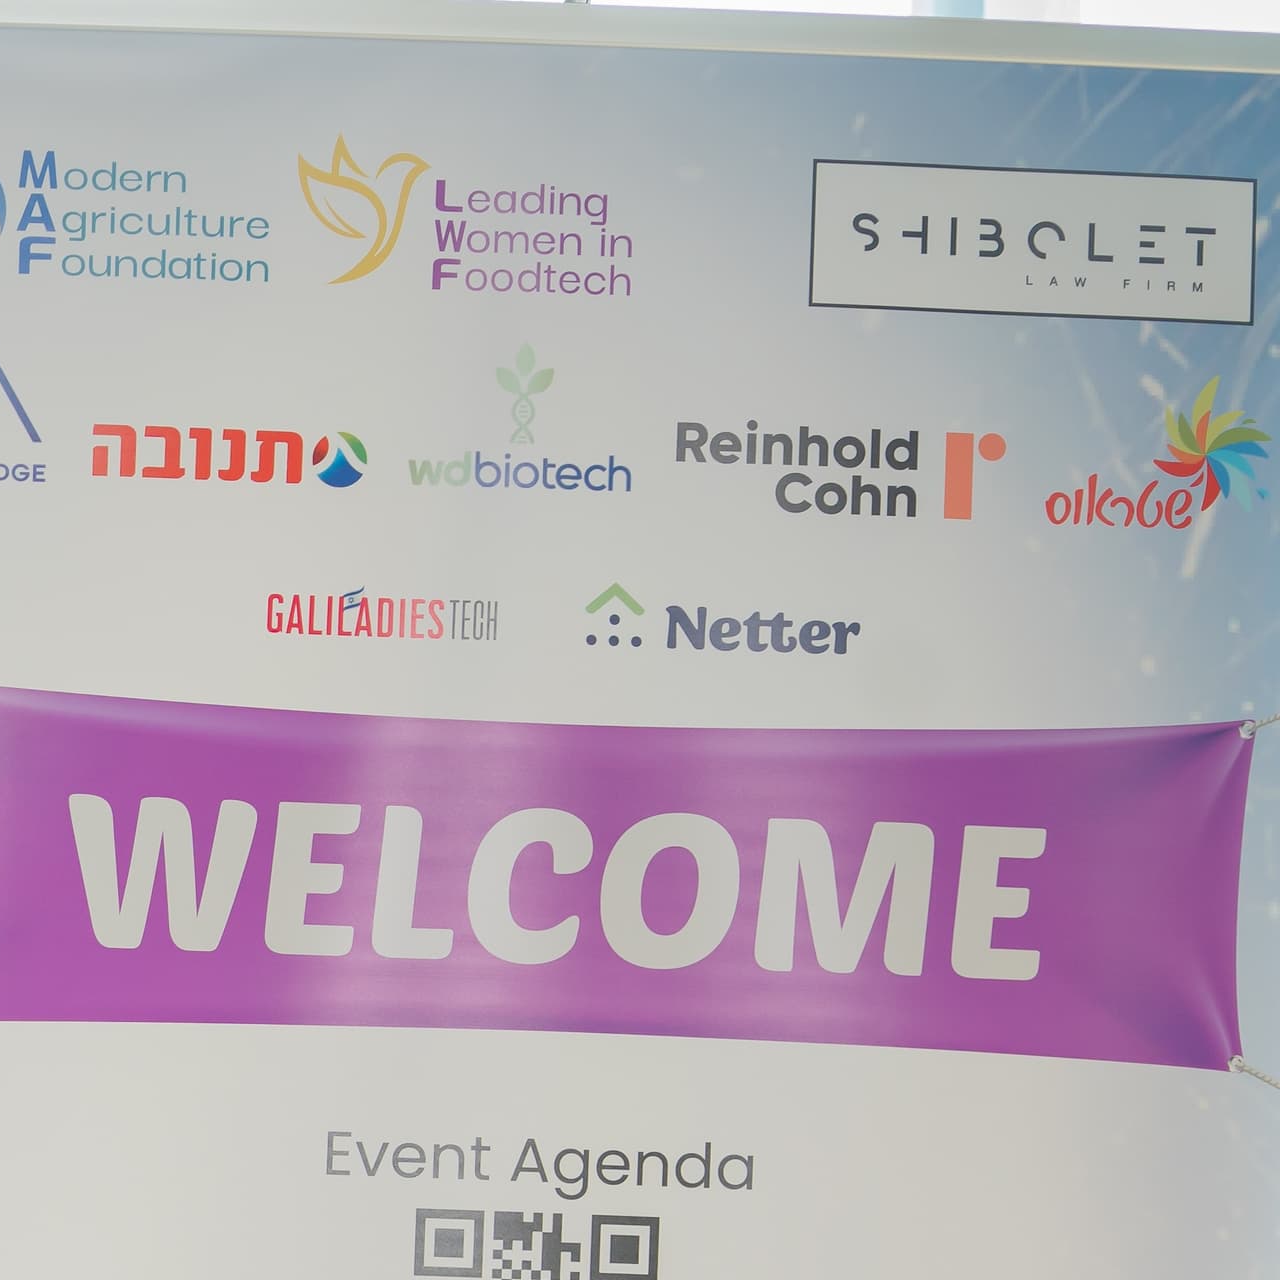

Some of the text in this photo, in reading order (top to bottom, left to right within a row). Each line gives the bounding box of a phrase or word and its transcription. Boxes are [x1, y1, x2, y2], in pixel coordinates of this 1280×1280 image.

[18, 150, 187, 193] Modern
[17, 192, 271, 241] Agriculture
[435, 180, 608, 226] Leading
[17, 236, 270, 283] Foundation
[435, 220, 633, 258] Women in
[852, 212, 1216, 266] SHIBOLET
[431, 258, 633, 296] Foodtech
[1025, 274, 1204, 293] LAW FIRM
[91, 423, 303, 484] תנובה
[675, 419, 919, 471] Reinhold
[407, 450, 633, 492] wdbiotech
[774, 472, 917, 518] Cohn
[665, 605, 862, 655] Netter
[68, 793, 1047, 982] WELCOME
[325, 1131, 755, 1200] Event Agenda
